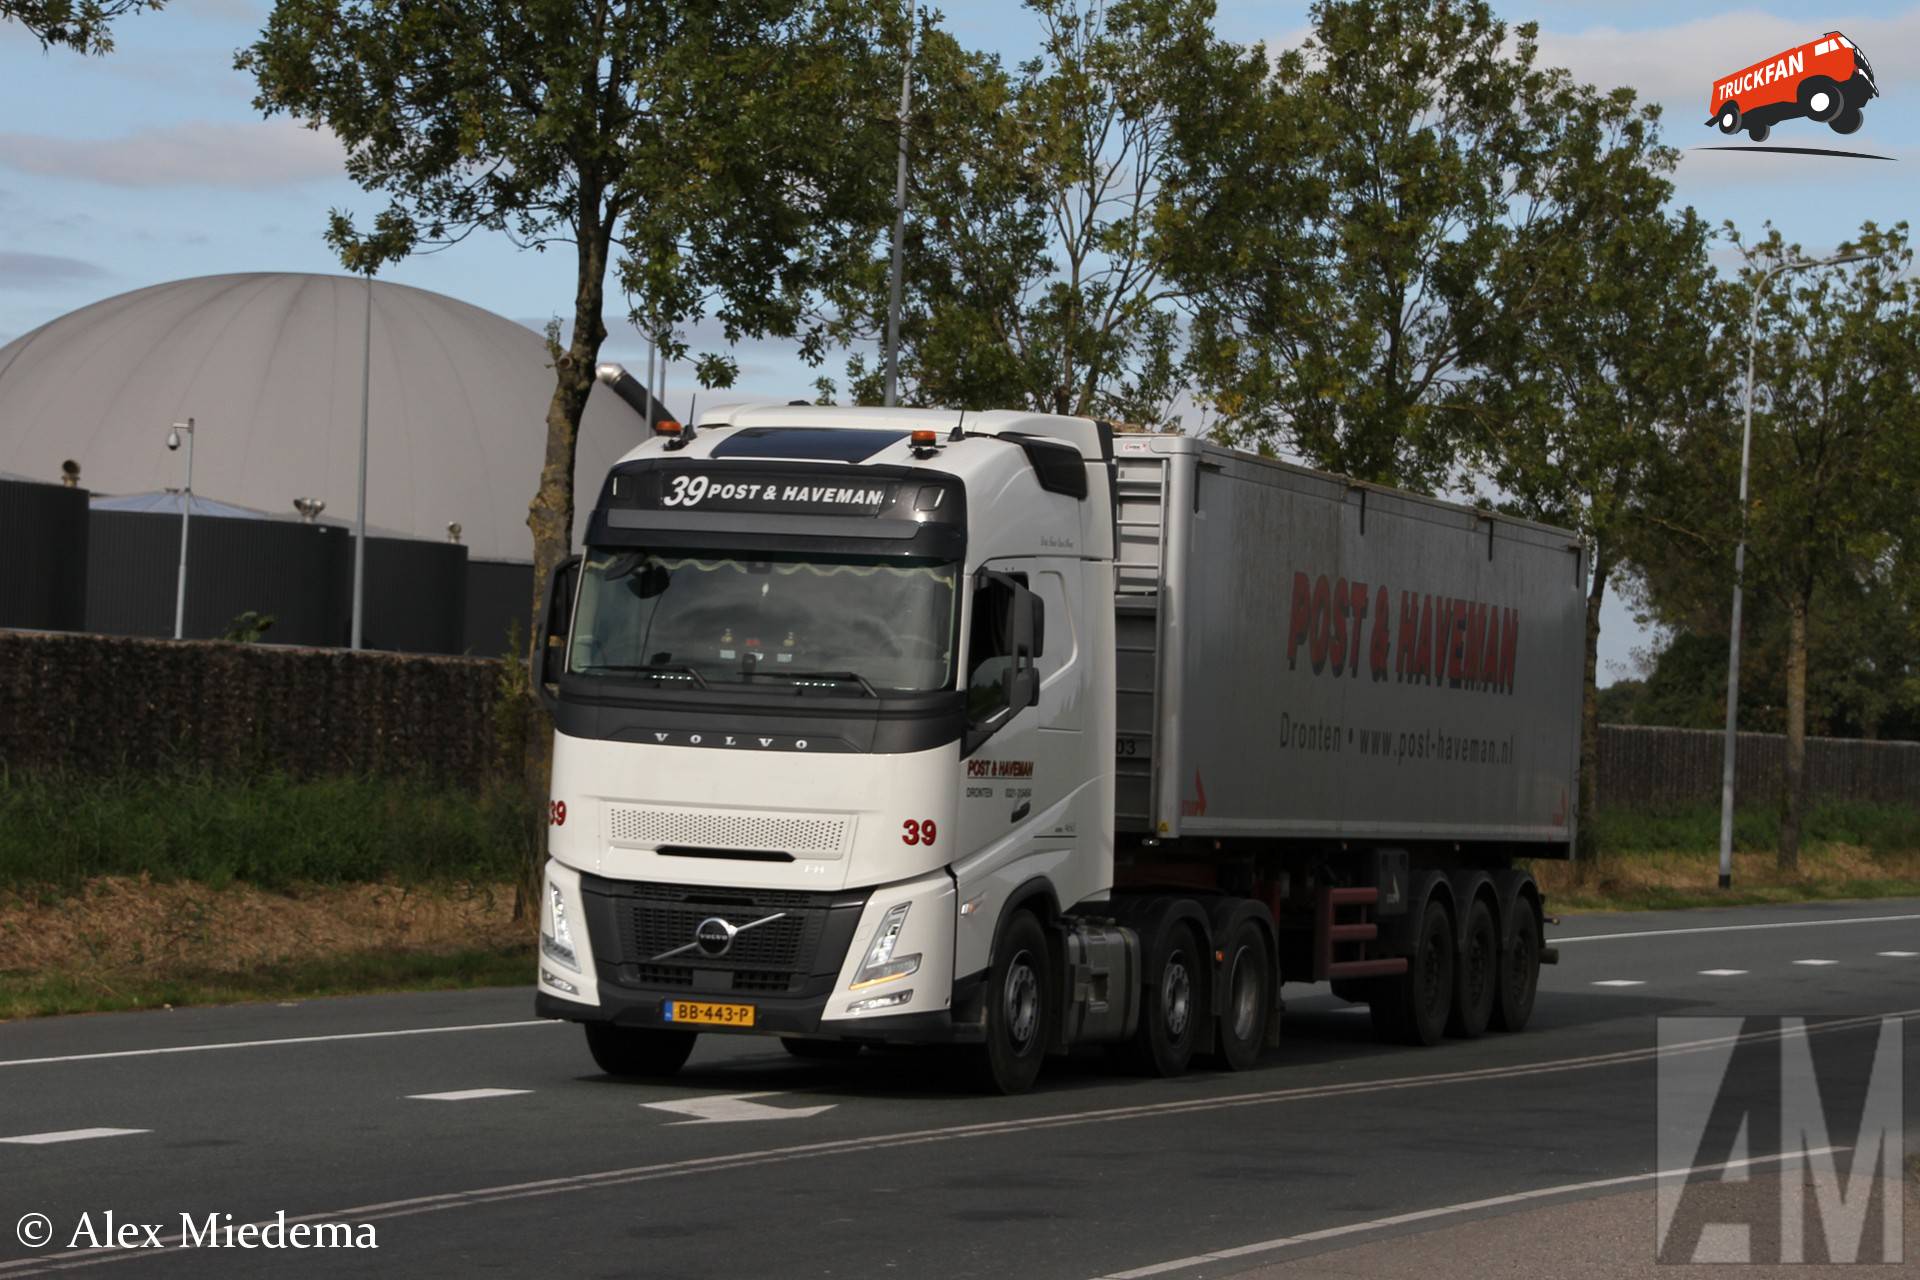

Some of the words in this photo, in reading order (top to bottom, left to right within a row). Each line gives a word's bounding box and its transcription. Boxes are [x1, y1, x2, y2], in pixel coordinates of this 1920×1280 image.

[664, 475, 709, 506] 39
[707, 484, 761, 499] POST
[762, 485, 776, 500] &
[782, 486, 882, 505] HAVEMAN
[1287, 571, 1368, 679] POST
[1369, 585, 1390, 682] &
[1395, 590, 1519, 695] HAVEMAN
[655, 733, 808, 749] VOLVO
[1279, 712, 1341, 752] Dronten
[1359, 726, 1515, 766] www.post-haveman.nl
[967, 759, 991, 776] POST
[999, 761, 1034, 777] HAVEMAN
[902, 819, 937, 846] 39
[679, 1004, 749, 1022] BB-443-P
